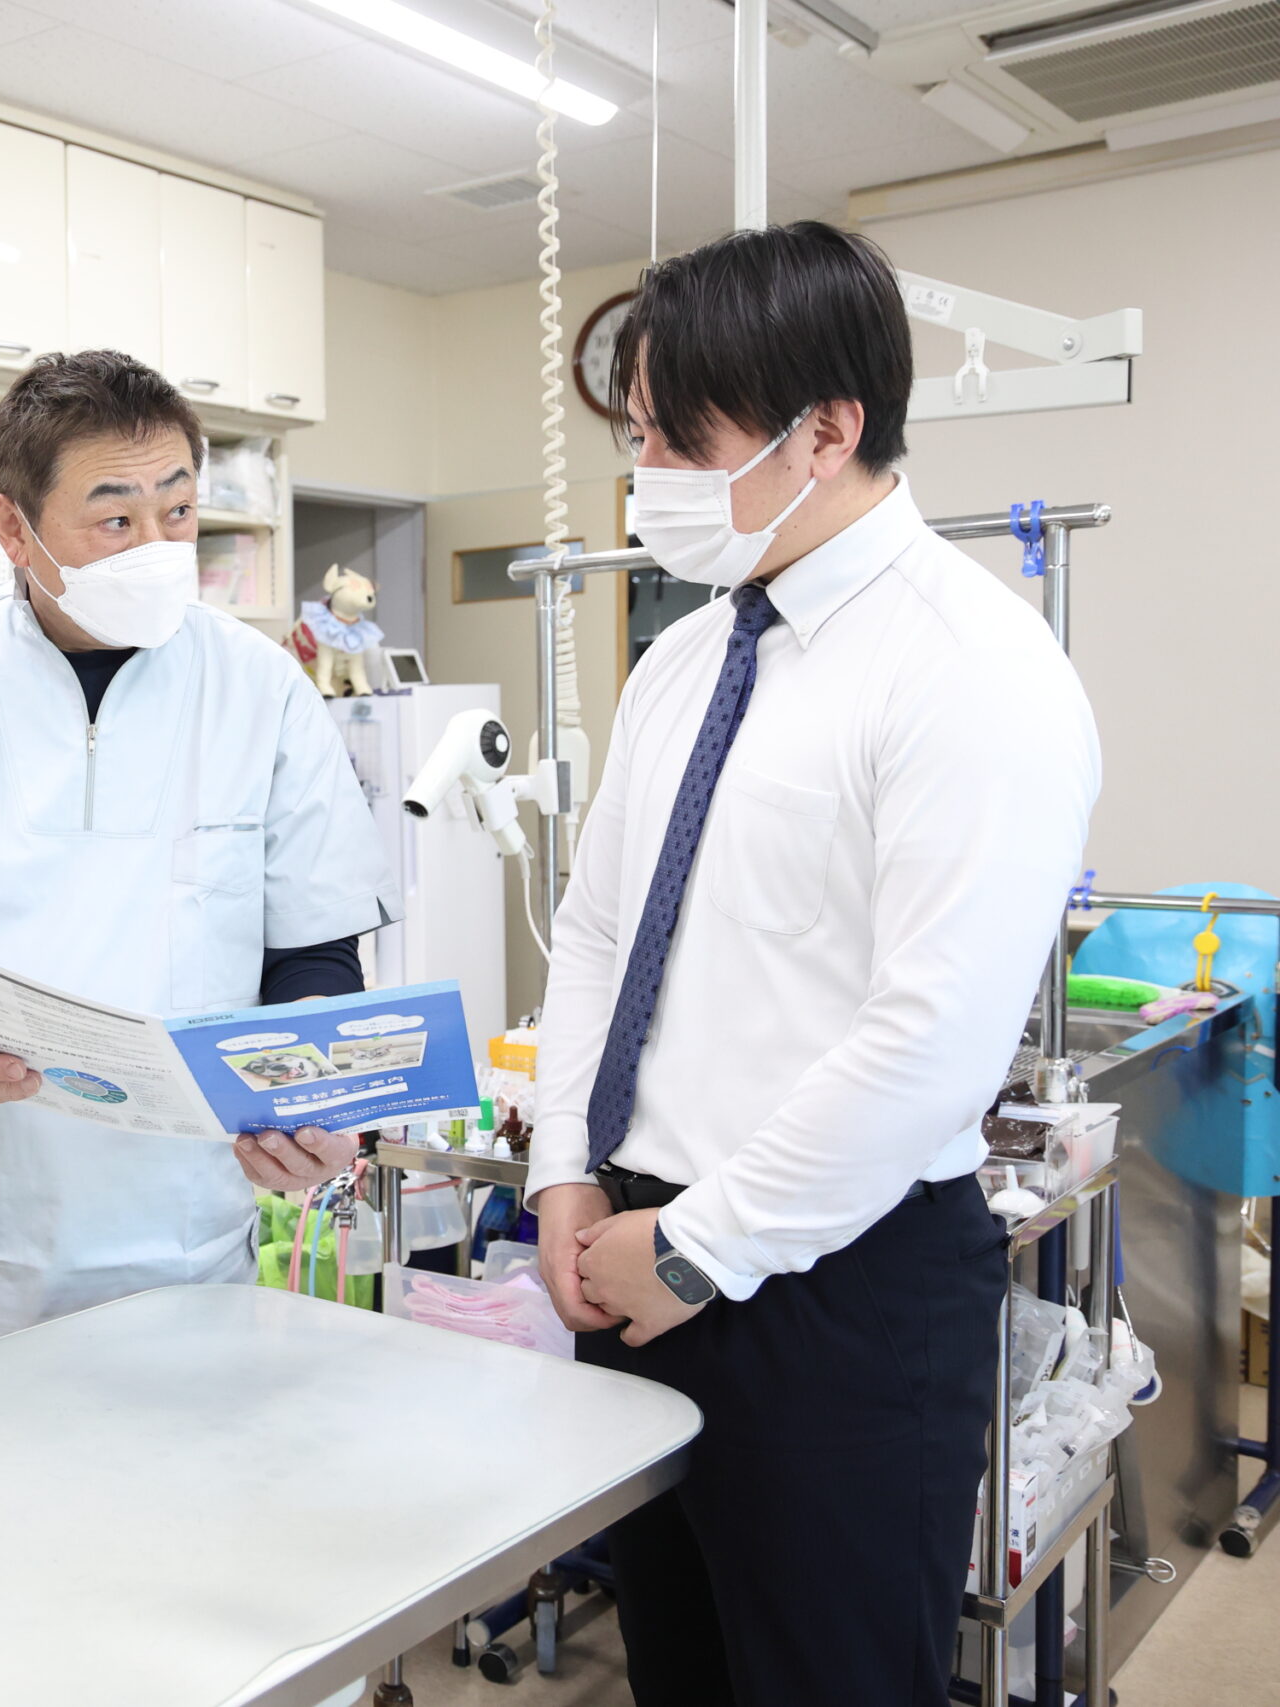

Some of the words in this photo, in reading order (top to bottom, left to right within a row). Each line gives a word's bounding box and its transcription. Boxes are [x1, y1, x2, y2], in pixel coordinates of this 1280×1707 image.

[188, 1014, 235, 1025] IDEXX
[272, 1087, 349, 1105] 検査結果
[351, 1075, 404, 1093] ご案内
